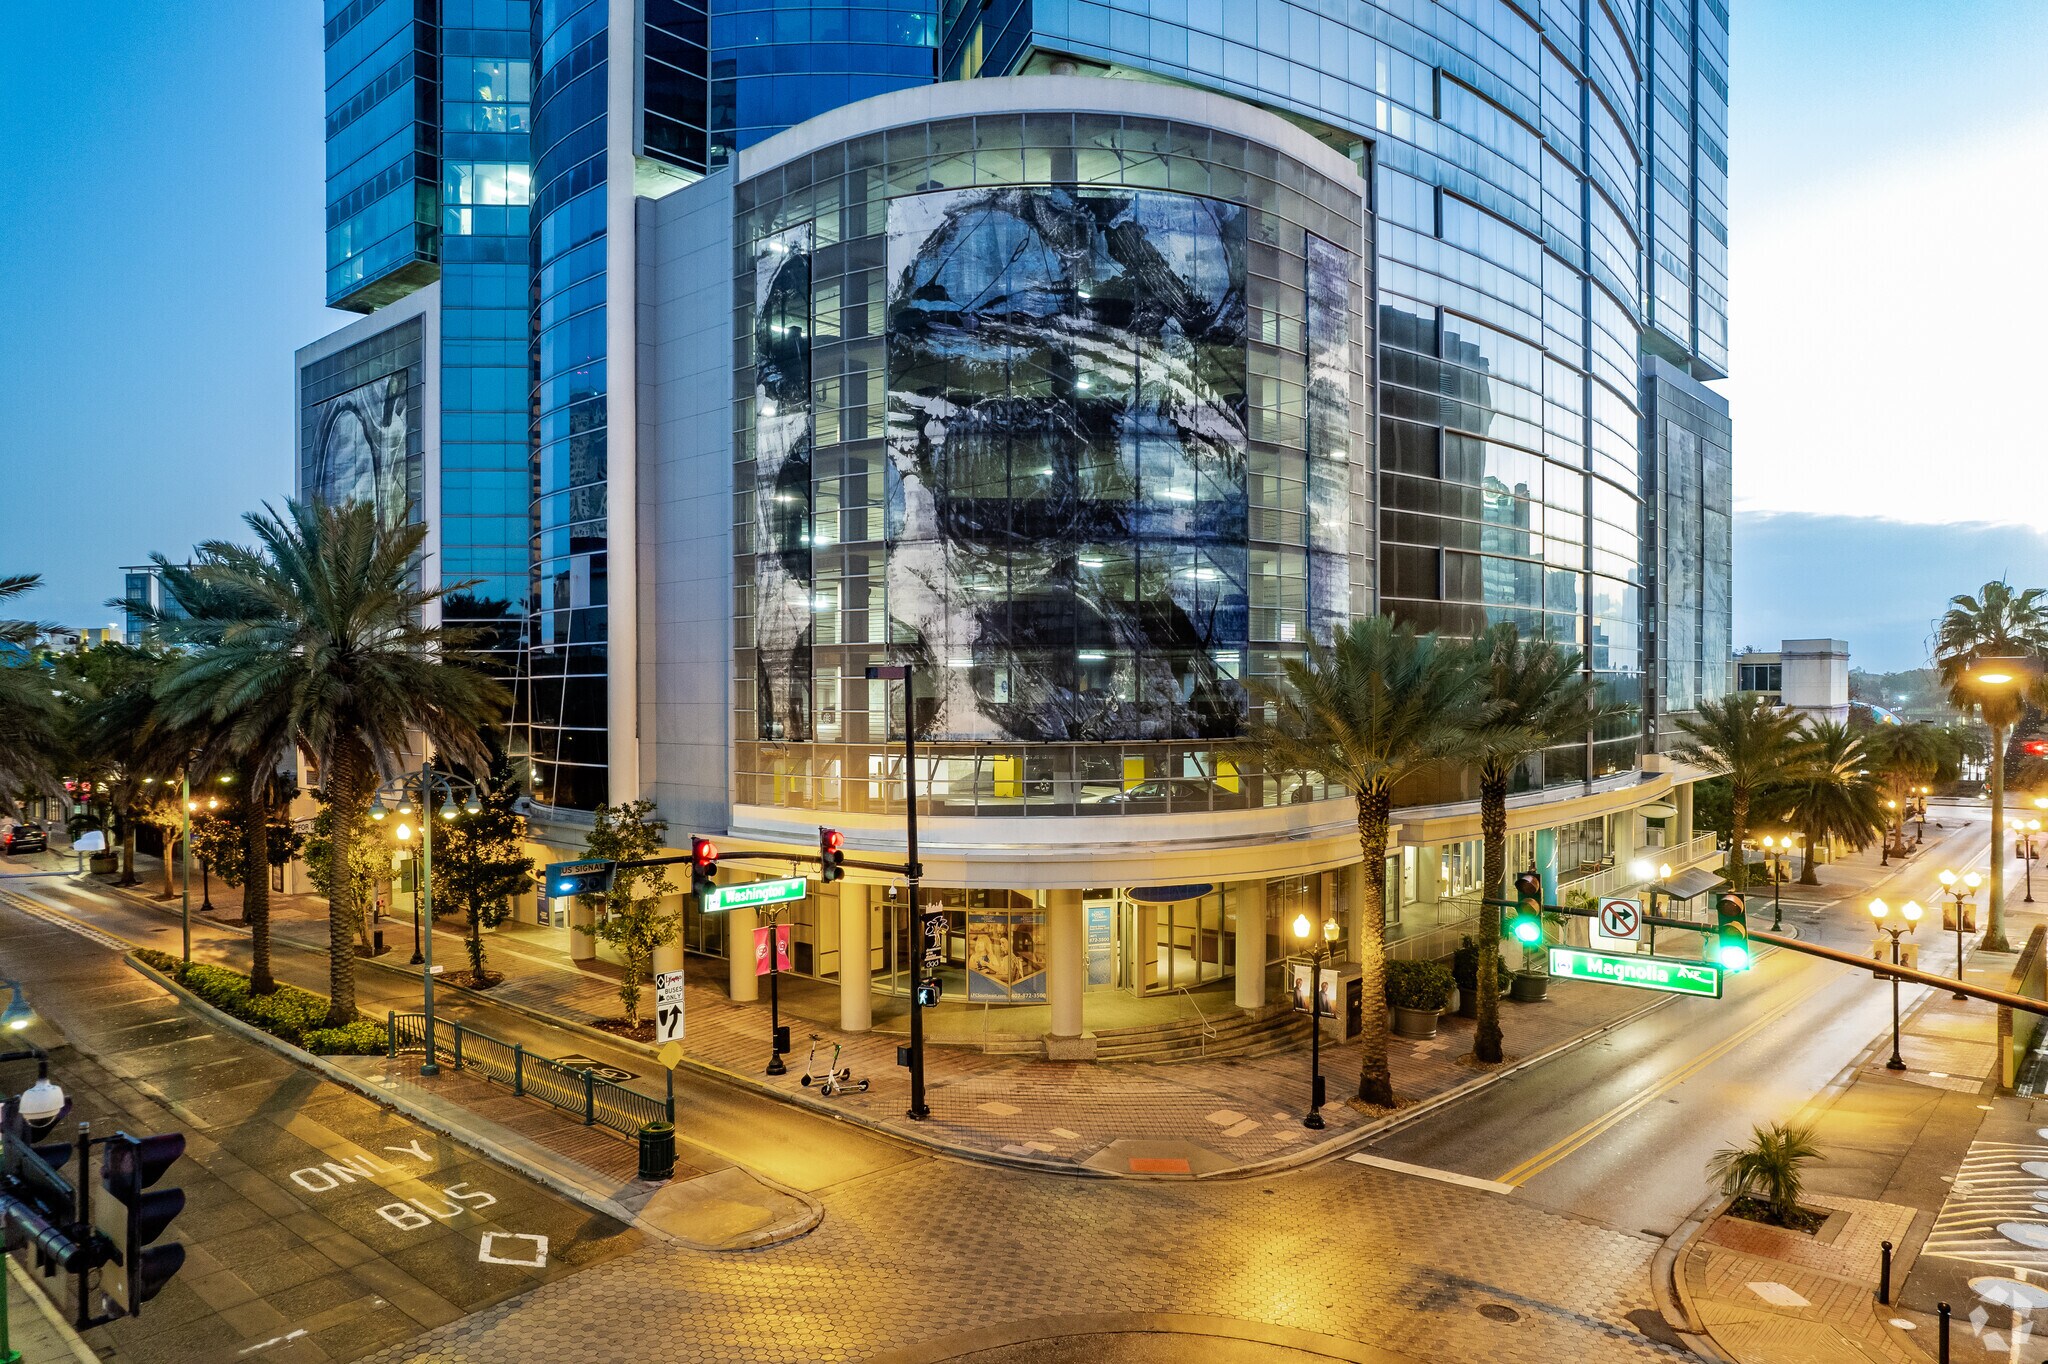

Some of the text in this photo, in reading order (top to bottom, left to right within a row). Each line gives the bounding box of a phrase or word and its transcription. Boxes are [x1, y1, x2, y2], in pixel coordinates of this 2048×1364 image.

[561, 863, 605, 874] US SIGNAL
[725, 885, 786, 903] Washington
[1586, 957, 1669, 982] Magnolia
[665, 986, 683, 995] BUSES
[665, 993, 682, 1001] ONLY
[289, 1139, 433, 1193] ONLY
[375, 1182, 498, 1231] BUS
